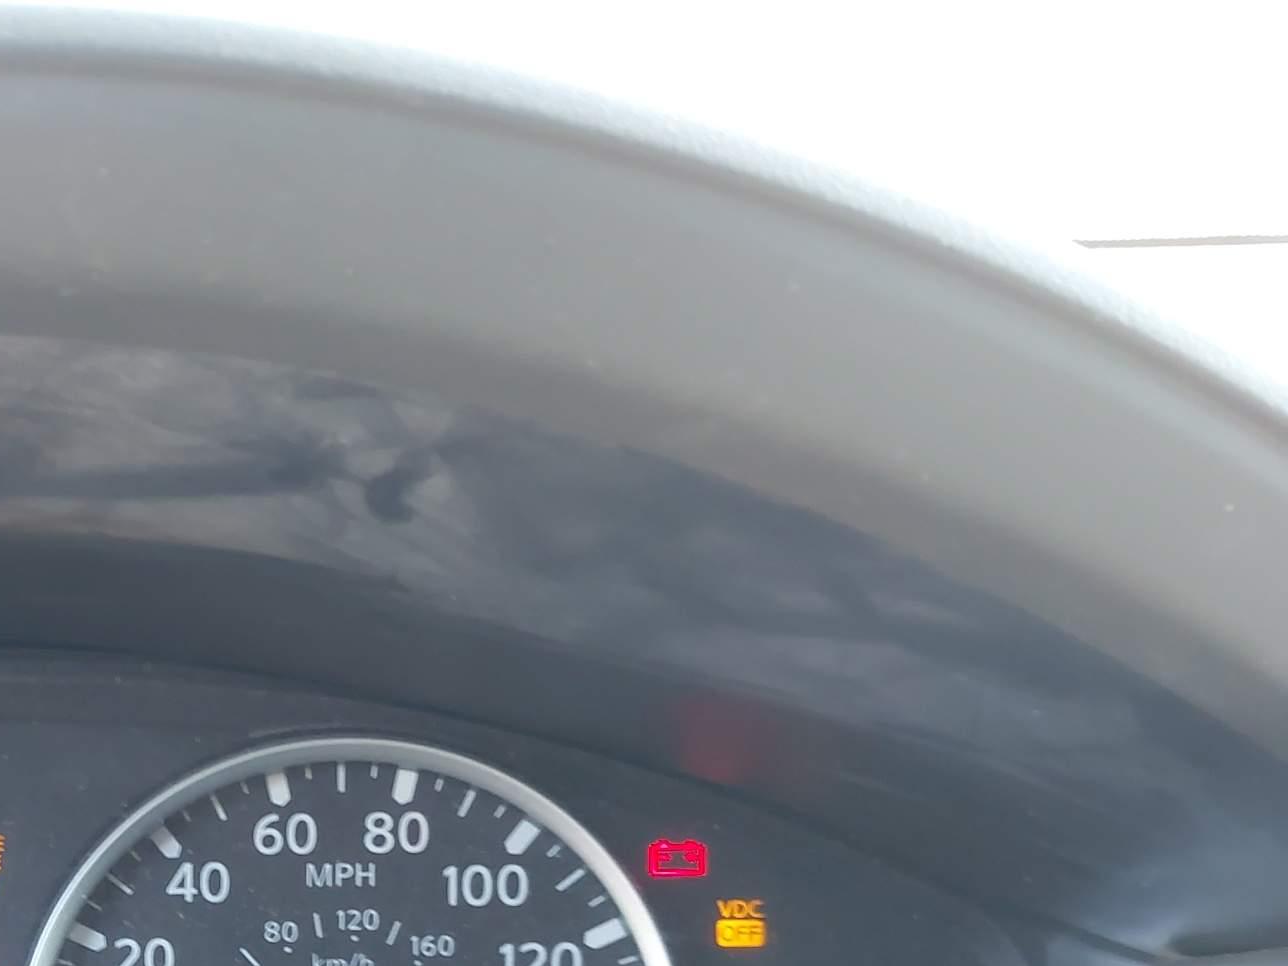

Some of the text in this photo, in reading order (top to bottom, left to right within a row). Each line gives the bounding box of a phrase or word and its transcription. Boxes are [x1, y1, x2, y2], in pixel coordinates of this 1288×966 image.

[253, 813, 317, 856] 60
[364, 811, 429, 855] 80
[166, 861, 231, 903] 40
[306, 862, 376, 889] MPH
[443, 865, 529, 908] 100
[336, 909, 380, 931] 120
[717, 900, 765, 918] VDC
[264, 920, 298, 943] 80
[720, 926, 762, 941] OFF
[410, 935, 455, 957] 160
